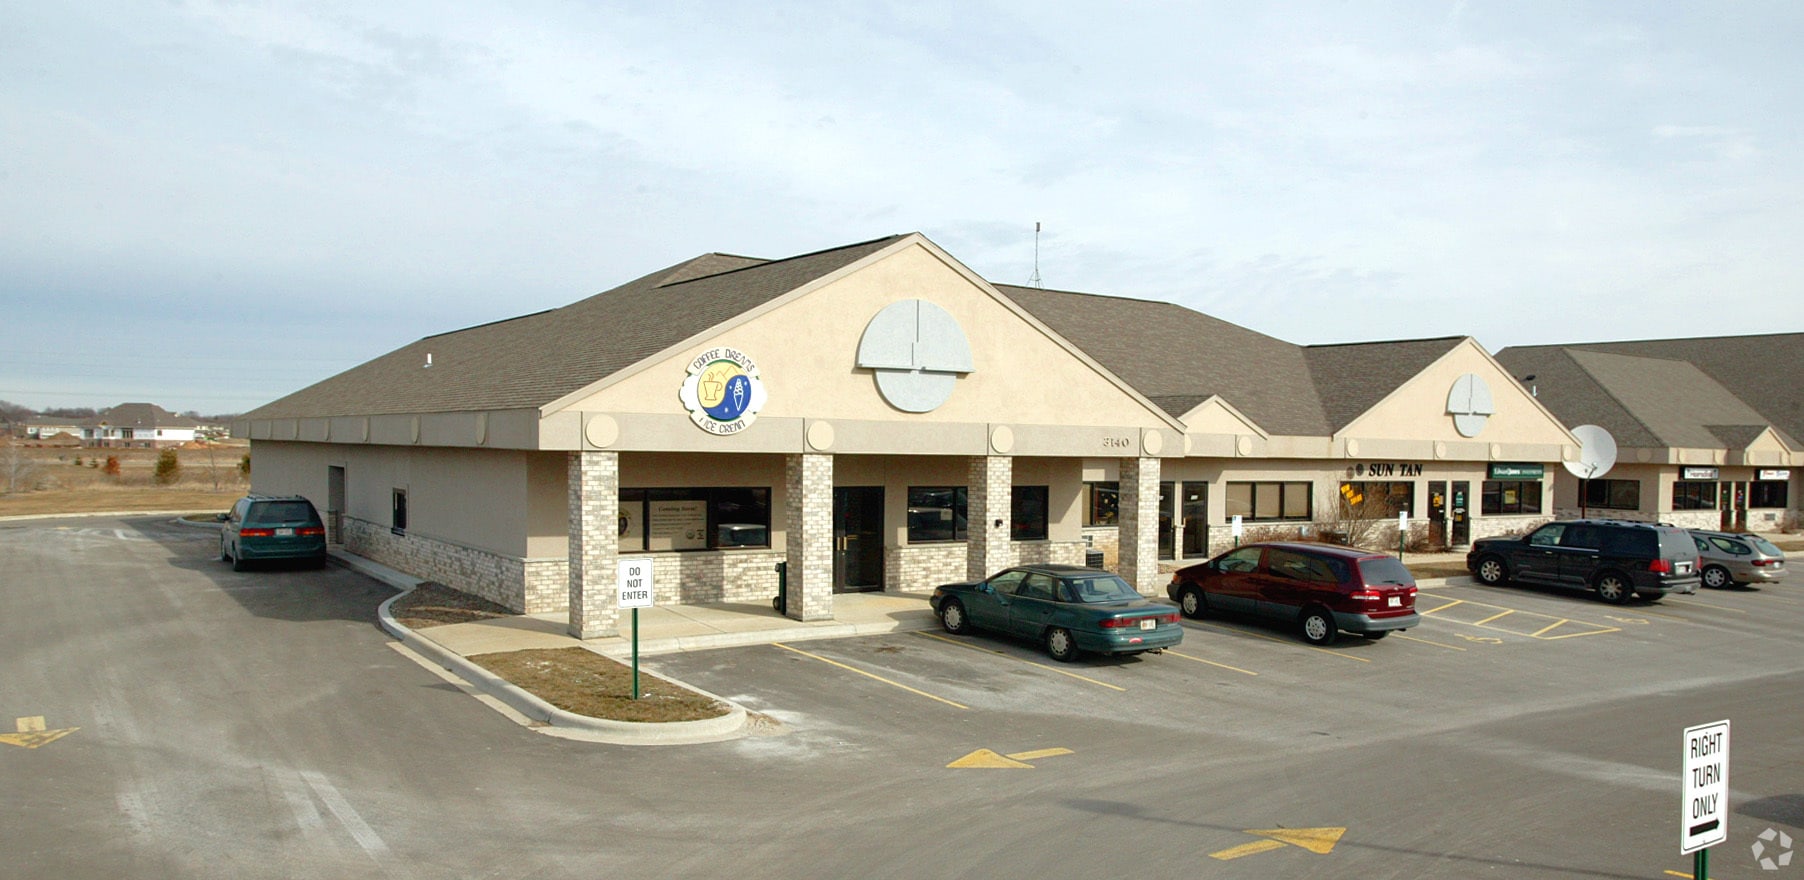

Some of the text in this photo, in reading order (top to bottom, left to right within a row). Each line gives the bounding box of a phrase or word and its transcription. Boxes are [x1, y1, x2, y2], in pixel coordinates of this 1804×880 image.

[693, 349, 720, 370] COFFEE
[703, 420, 717, 432] ICE
[1103, 438, 1130, 448] 3140
[1369, 463, 1423, 477] SUN TAN
[629, 567, 641, 576] DO
[627, 579, 643, 588] NOT
[622, 591, 648, 600] ENTER
[1691, 732, 1722, 759] RIGHT
[1692, 763, 1720, 788] TURN
[1693, 793, 1718, 819] ONLY
